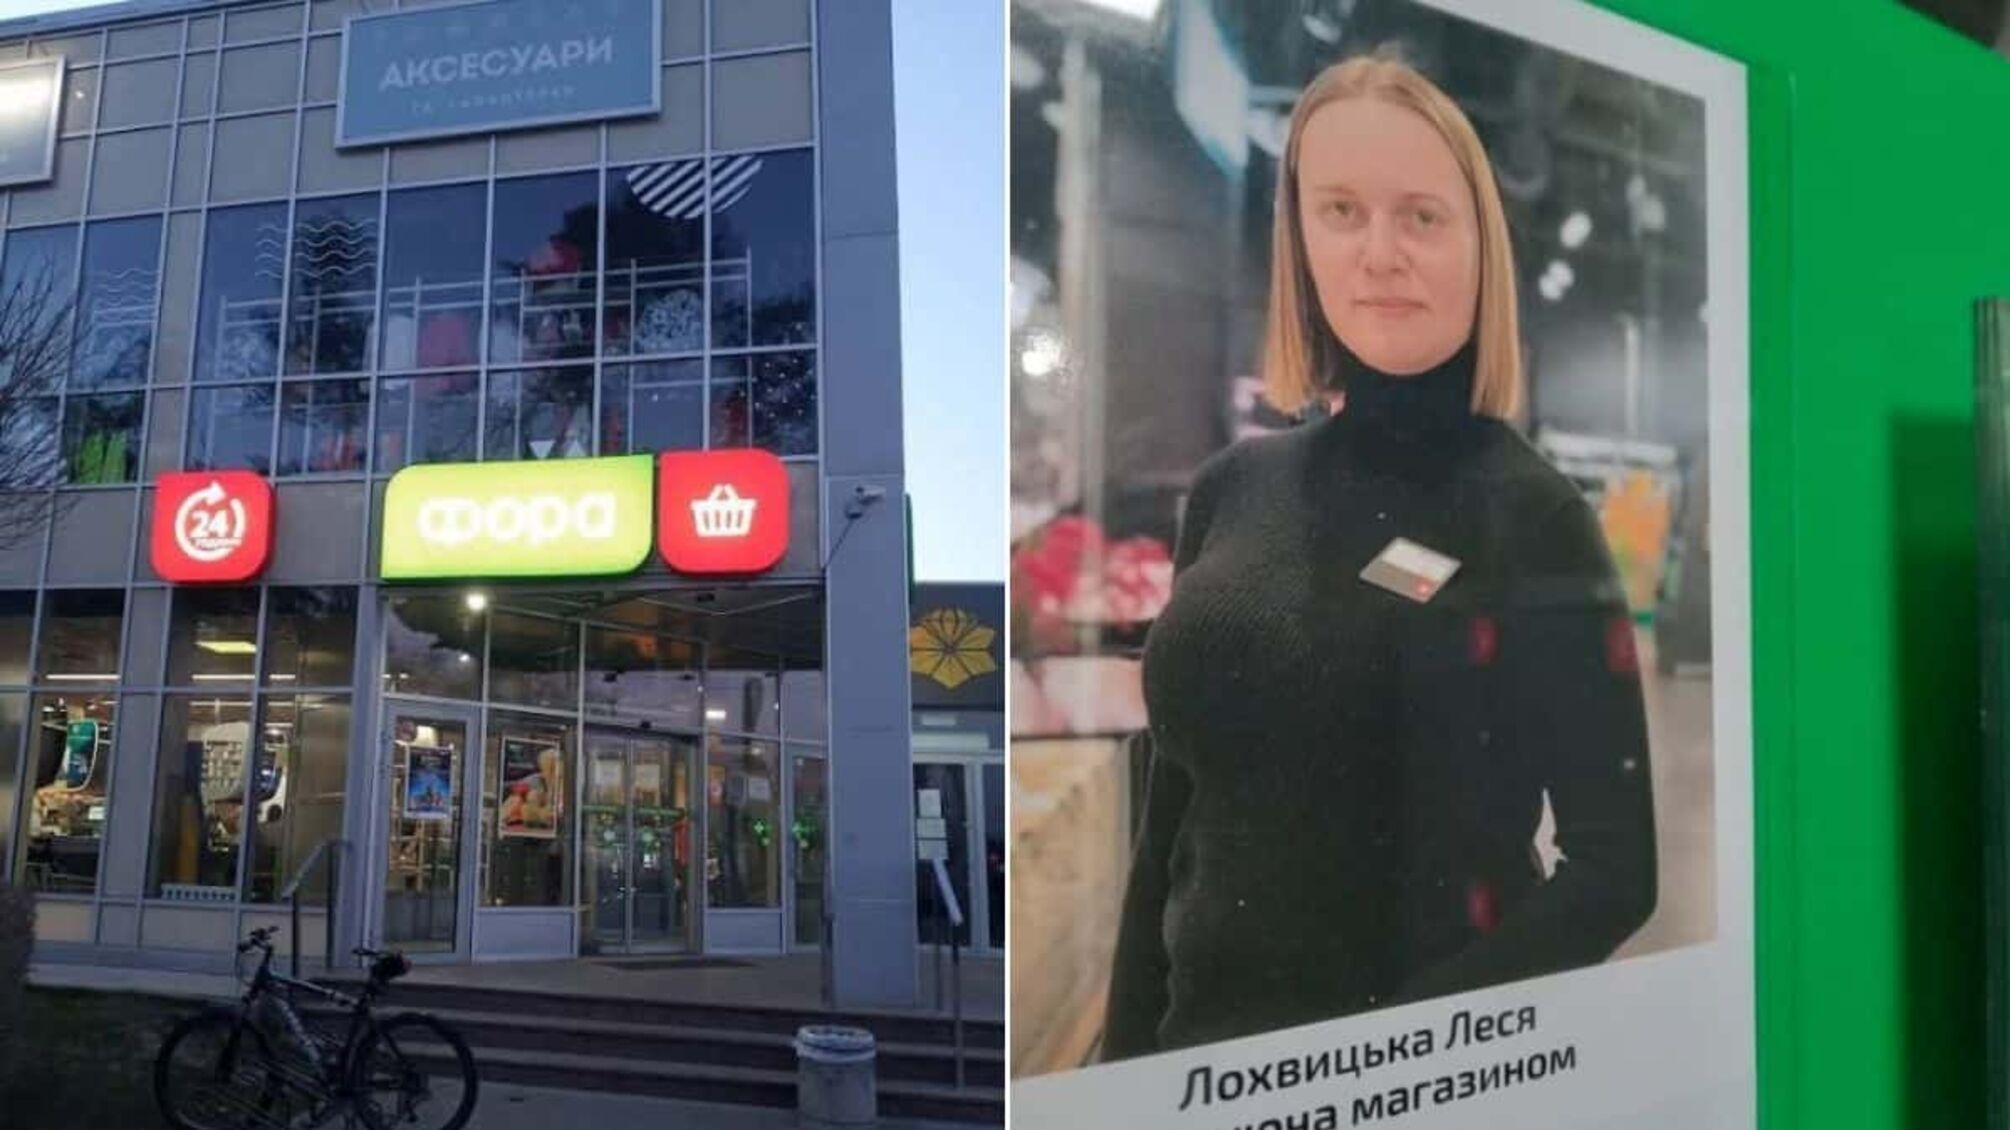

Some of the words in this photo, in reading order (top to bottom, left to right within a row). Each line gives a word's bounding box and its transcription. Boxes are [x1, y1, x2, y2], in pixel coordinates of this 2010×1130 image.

[379, 35, 614, 91] АКСЕСУАРИ
[190, 509, 229, 538] 24
[1179, 1028, 1434, 1112] Лохвицька
[1445, 1006, 1537, 1050] Леся
[1352, 1046, 1577, 1126] магазином
